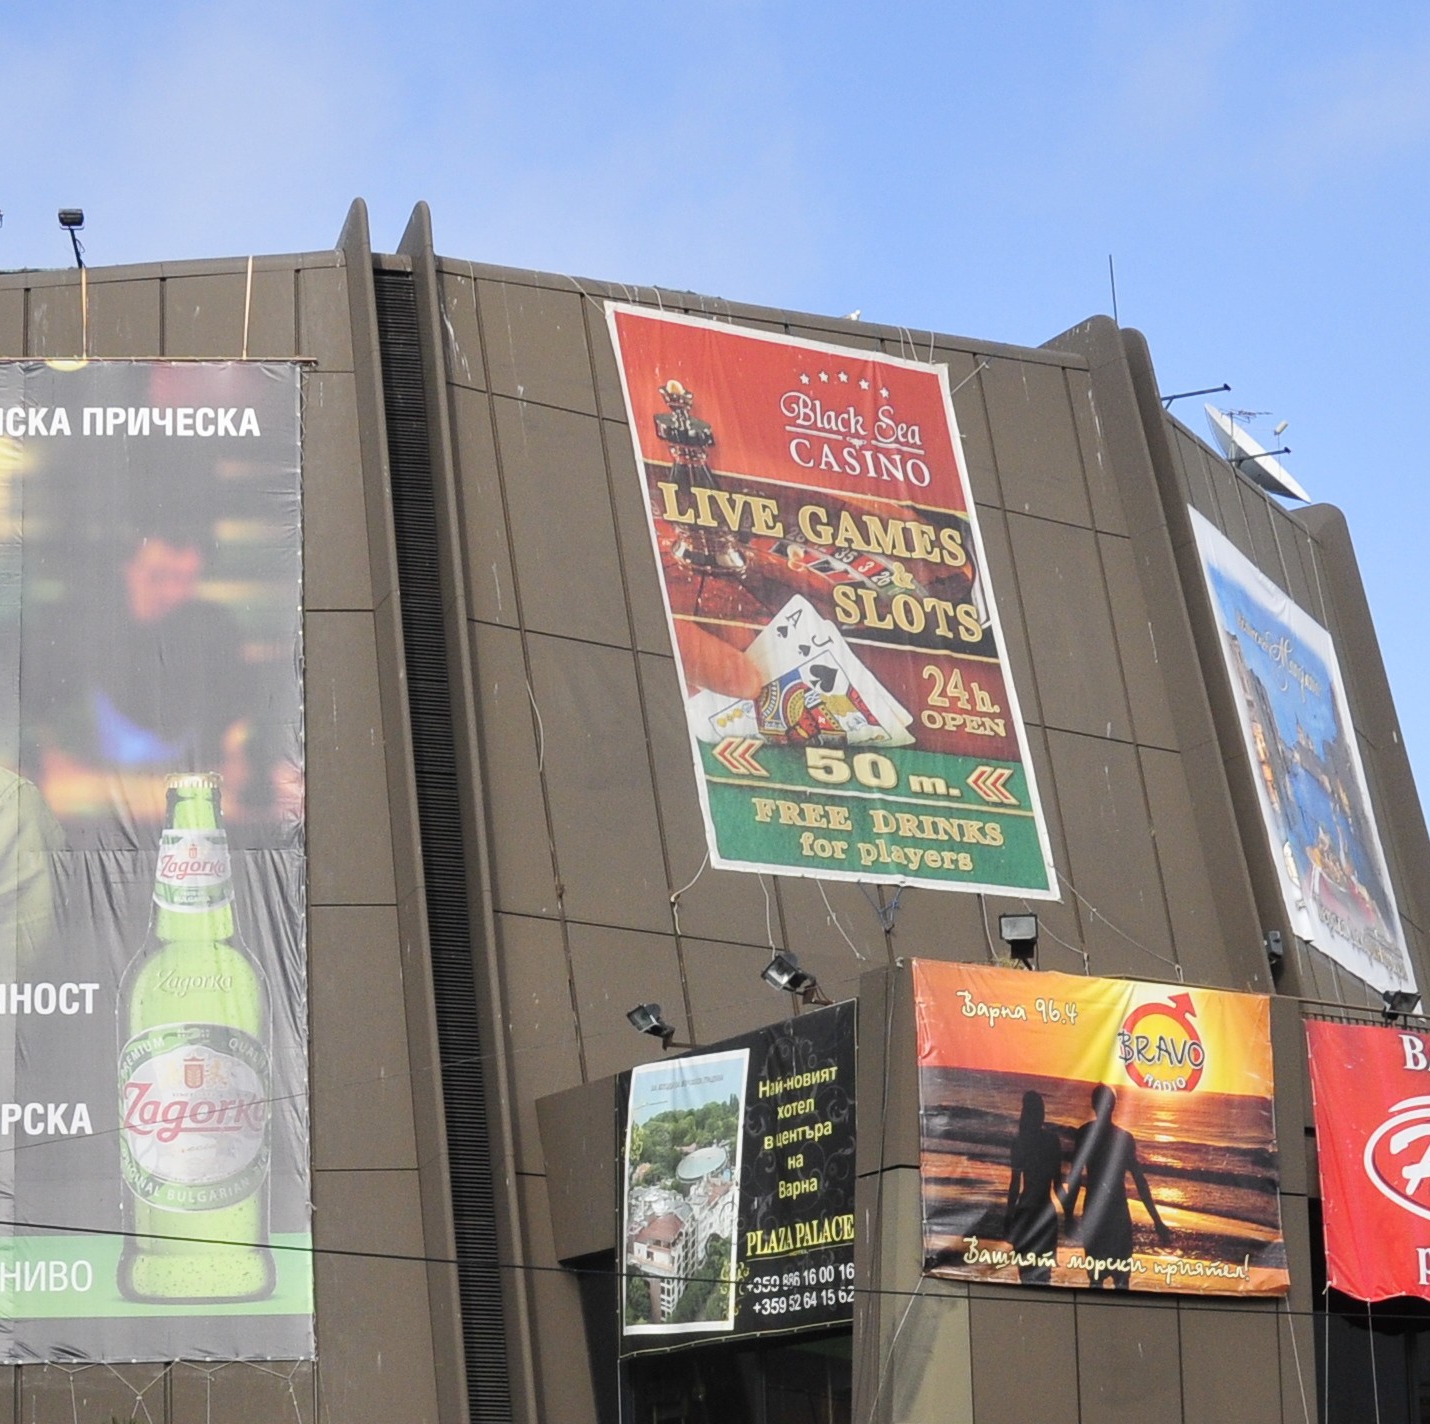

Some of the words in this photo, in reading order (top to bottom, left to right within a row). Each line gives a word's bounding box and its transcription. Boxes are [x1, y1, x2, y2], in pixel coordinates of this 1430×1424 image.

[82, 407, 261, 438] ПРИЧЕСКА
[780, 391, 868, 436] Black
[874, 405, 922, 446] Sea
[789, 437, 931, 488] CASINO
[657, 481, 784, 538] LIVE
[797, 504, 967, 567] GAMES
[890, 561, 915, 590] &
[832, 585, 983, 642] SLOTS
[921, 710, 1007, 738] OPEN
[805, 746, 898, 789] 50
[908, 774, 962, 797] m.
[752, 797, 852, 831] FREE
[869, 809, 1004, 846] DRINKS
[800, 832, 849, 858] for
[858, 839, 974, 872] players
[154, 968, 233, 996] Zagorka
[956, 990, 1027, 1027] Варна
[1035, 998, 1078, 1025] 96.4
[1117, 1029, 1206, 1069] BRAVO
[758, 1064, 838, 1099] Най-новият
[1142, 1073, 1187, 1092] RADIO
[123, 1081, 267, 1143] Zagorka
[776, 1097, 815, 1120] хотел
[775, 1121, 833, 1148] центъра
[787, 1154, 804, 1170] на
[778, 1178, 818, 1200] Варна
[746, 1226, 793, 1257] PLAZA
[794, 1213, 855, 1248] PALACE
[0, 1258, 93, 1293] НИВО
[803, 1268, 817, 1286] 16
[819, 1265, 835, 1283] 00
[839, 1262, 855, 1280] 16
[962, 1236, 1057, 1269] Вашият
[1066, 1255, 1147, 1281] морски
[753, 1297, 787, 1315] +359
[789, 1294, 802, 1312] 52
[803, 1291, 818, 1309] 64
[821, 1289, 836, 1306] 15
